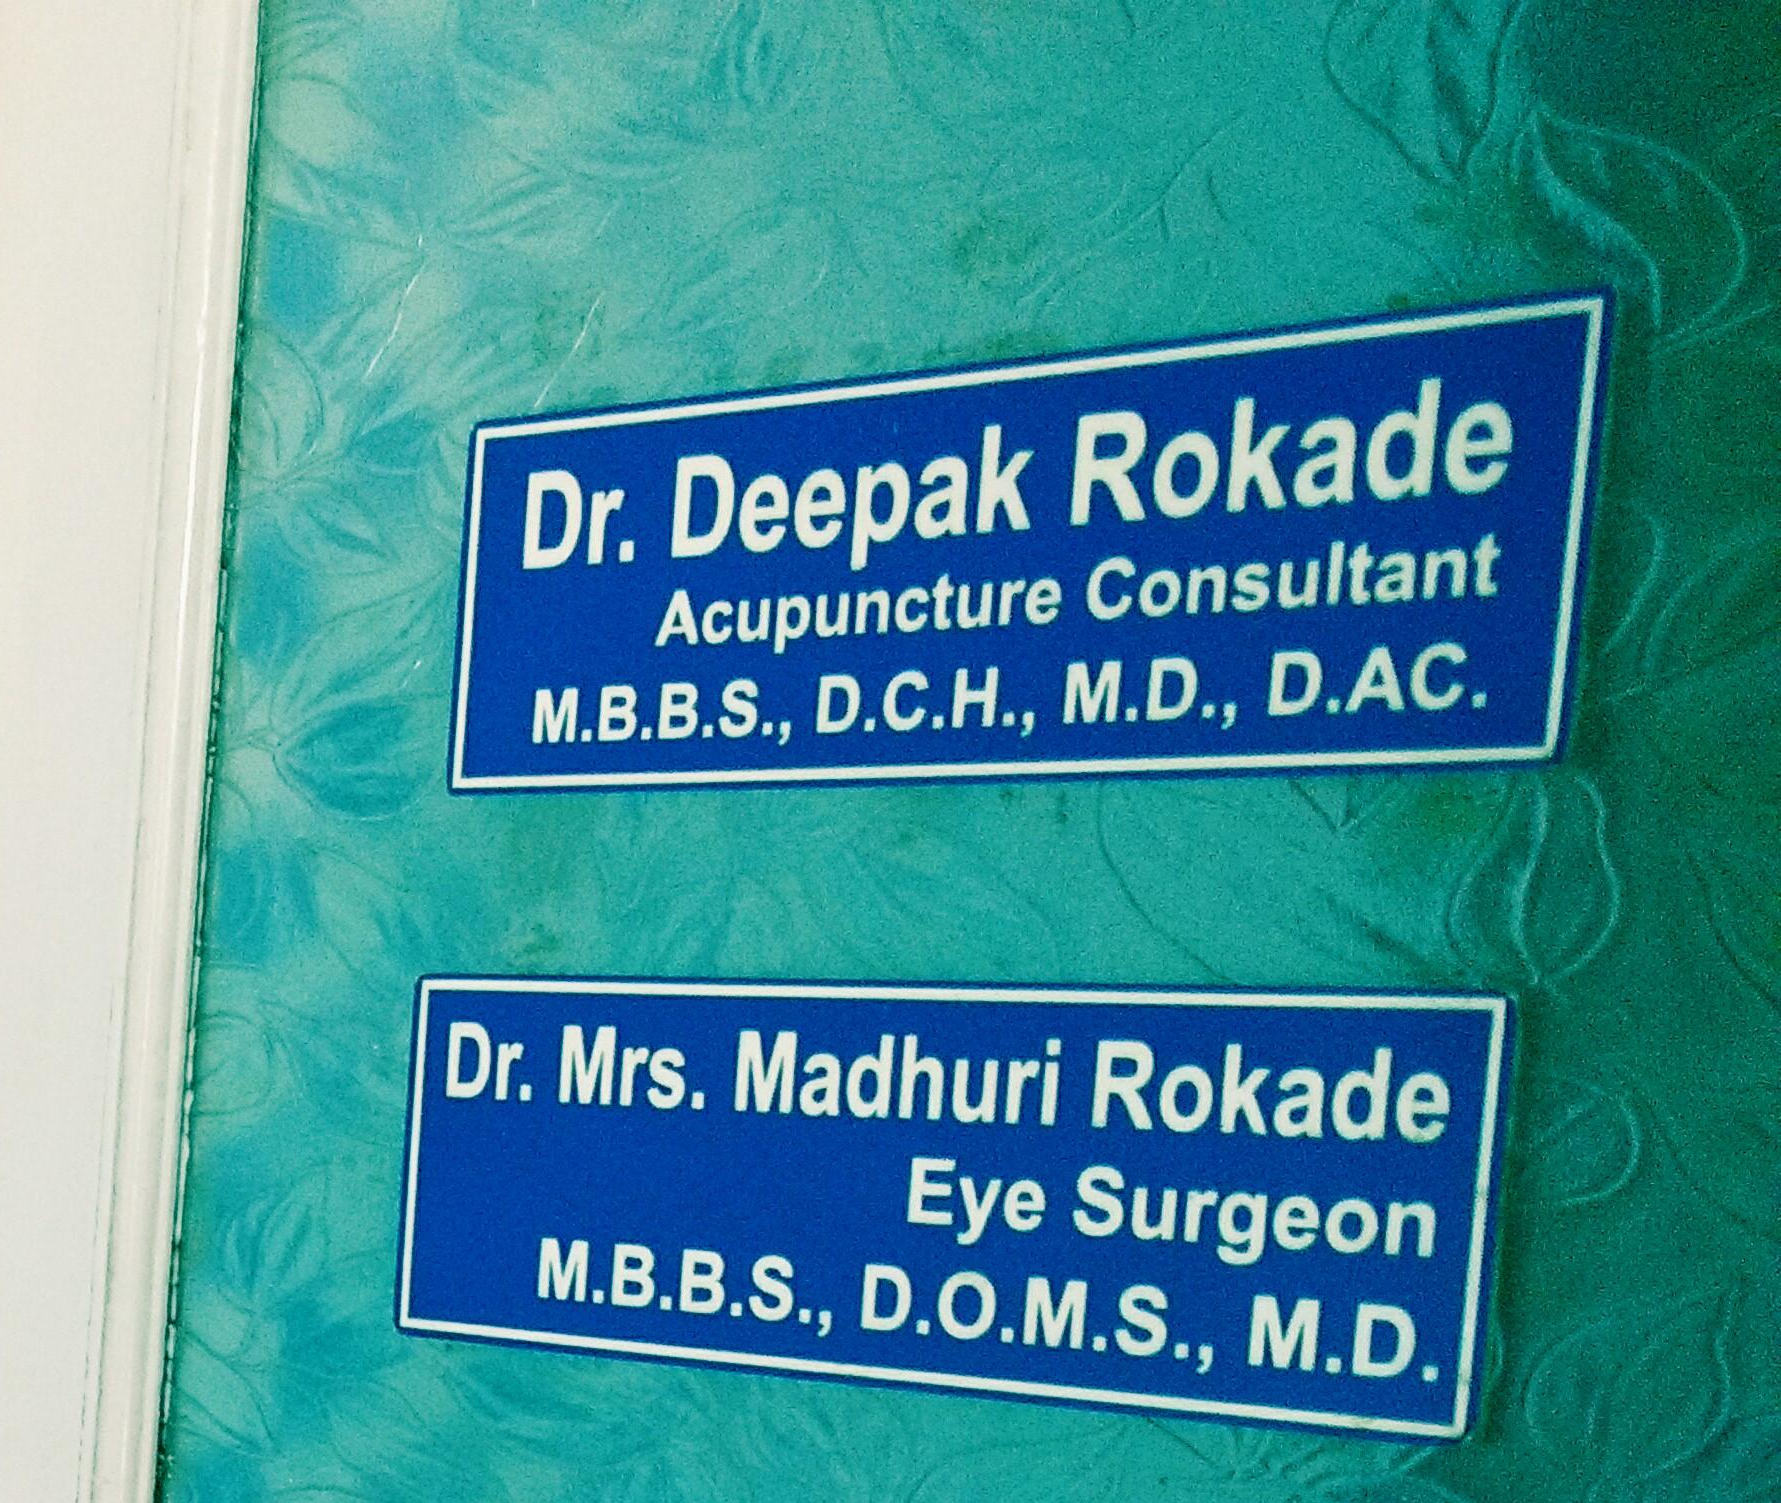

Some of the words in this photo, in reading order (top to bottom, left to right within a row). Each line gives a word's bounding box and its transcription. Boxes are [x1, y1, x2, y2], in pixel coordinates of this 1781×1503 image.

[521, 468, 636, 571] Dr.
[670, 423, 1033, 572] Deepak
[1070, 378, 1513, 526] Rokade
[654, 573, 1063, 655] Acupuncture
[1085, 534, 1501, 622] Consultant
[531, 674, 792, 748] M.B.B.S.,
[815, 665, 1036, 735] D.C.H.,
[1062, 656, 1237, 728] M.D.,
[1267, 642, 1487, 717] D.AC.
[445, 1020, 533, 1102] Dr.
[557, 1023, 706, 1111] Mrs.
[733, 1029, 1062, 1126] Madhuri
[1091, 1038, 1451, 1142] Rokade
[906, 1156, 1047, 1246] Eye
[1072, 1164, 1437, 1266] Surgeon
[537, 1236, 833, 1337] M.B.B.S.,
[860, 1262, 1214, 1374] D.O.M.S.,
[1247, 1294, 1439, 1382] M.D.
